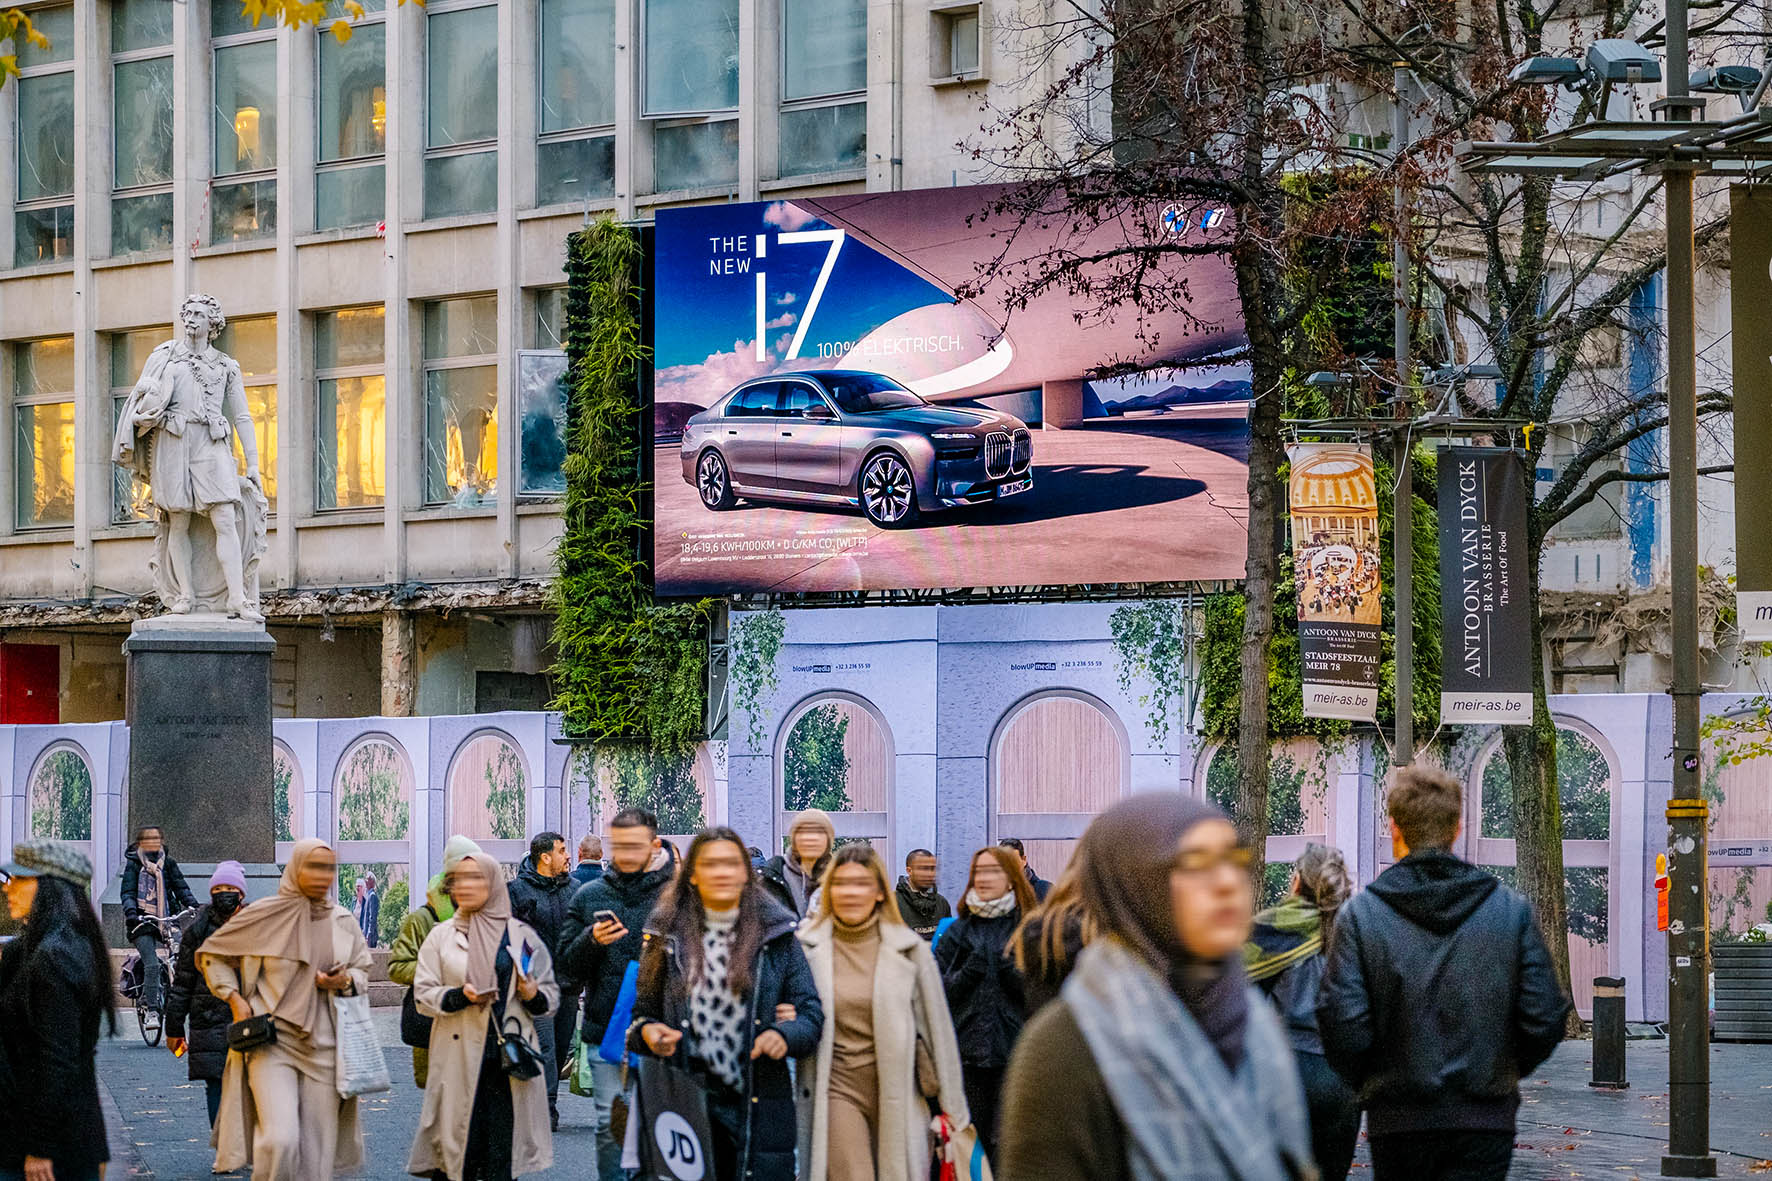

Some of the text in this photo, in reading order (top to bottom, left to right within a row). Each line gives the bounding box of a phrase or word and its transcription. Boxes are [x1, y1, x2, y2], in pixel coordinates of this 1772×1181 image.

[709, 235, 747, 253] THE
[710, 257, 751, 275] NEW
[755, 228, 845, 362] i7
[816, 335, 964, 359] 100% ELEKTRISCH.
[721, 540, 775, 552] KWH/100KM
[792, 538, 816, 550] G/KM
[1459, 460, 1480, 678] ANTOON VAN DYCK
[1481, 524, 1494, 613] BRASSERIE
[1498, 531, 1509, 607] The Art Of Food
[1303, 628, 1377, 640] ANTOON VAN DYCK
[1305, 651, 1378, 664] STADSFEESTZAAL
[1306, 662, 1341, 671] MEIR 78
[1313, 692, 1368, 707] meir-as.be
[1452, 699, 1521, 711] meir-as.be
[669, 1129, 695, 1165] JD
